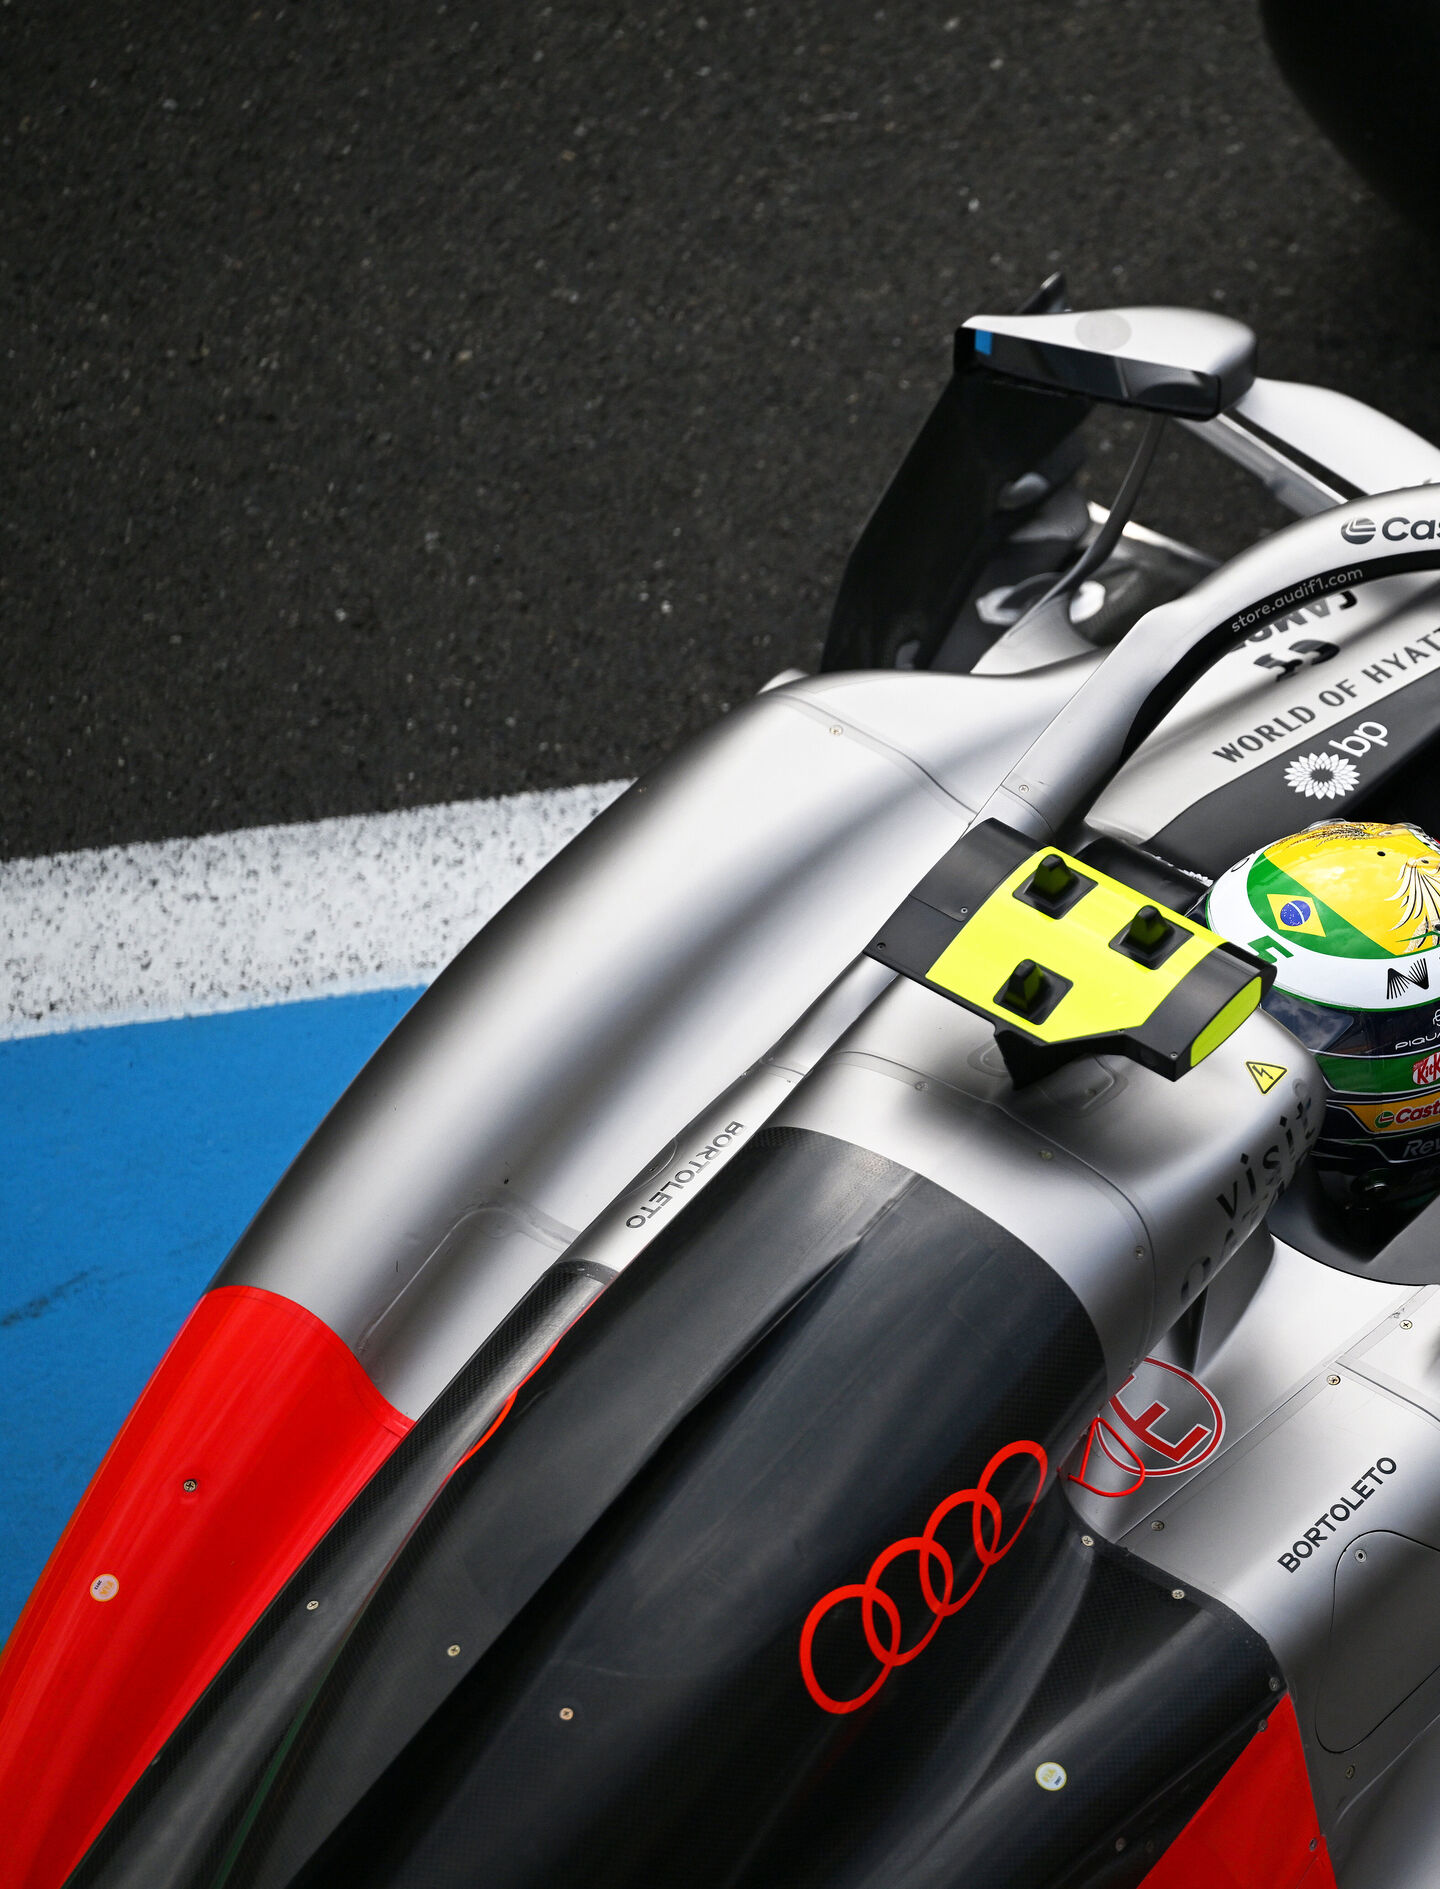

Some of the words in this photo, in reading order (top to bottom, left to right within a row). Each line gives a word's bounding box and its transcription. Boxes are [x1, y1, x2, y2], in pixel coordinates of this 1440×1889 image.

[1231, 568, 1364, 632] store.audif1.com
[1212, 706, 1316, 763] WORLD
[1318, 679, 1358, 707] OF
[1328, 721, 1389, 758] bp
[625, 1120, 745, 1229] BORTOLETO
[1278, 1456, 1398, 1574] BORTOLETO
